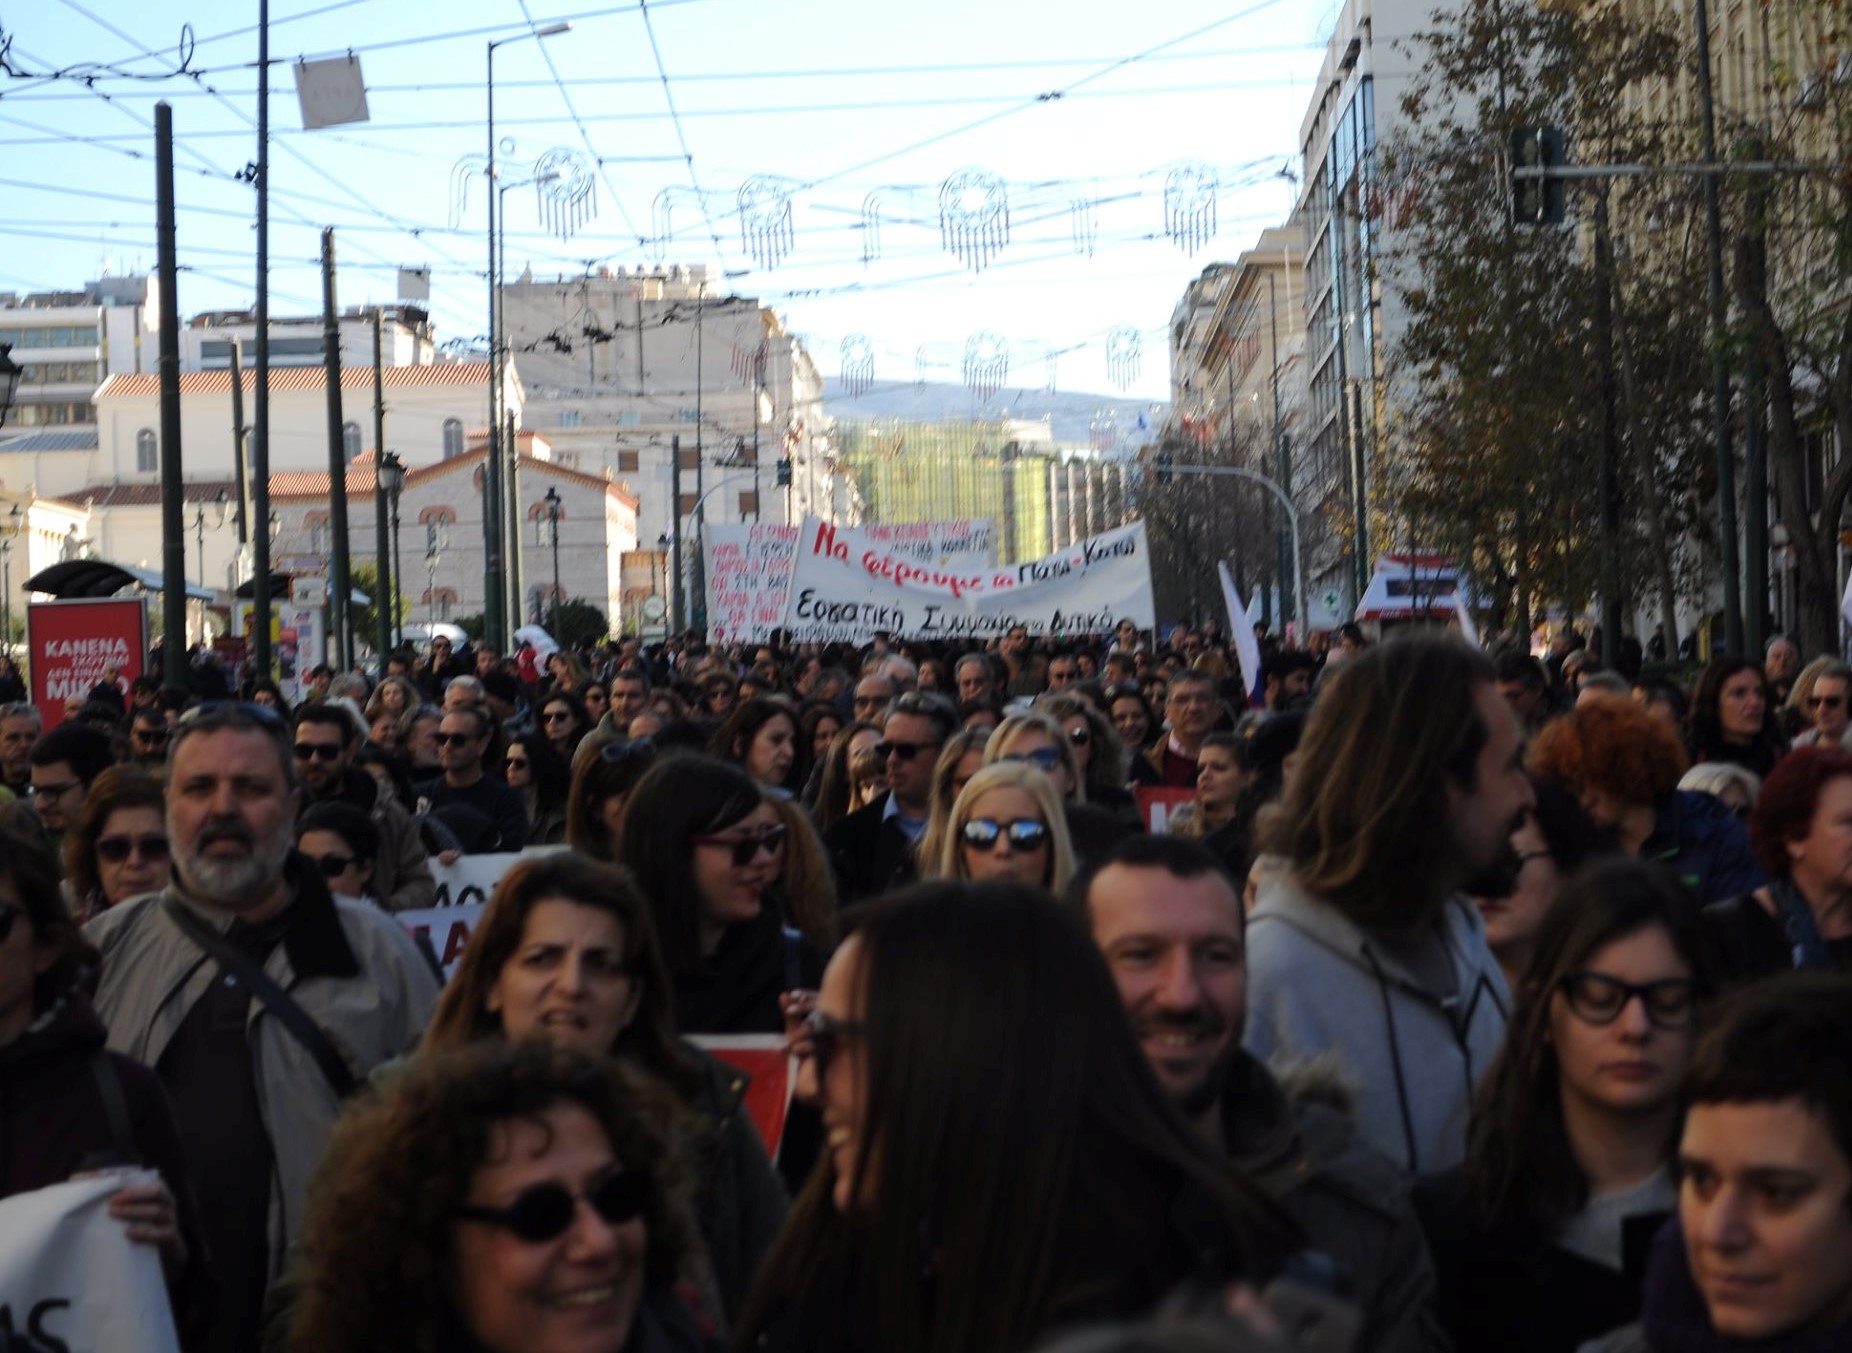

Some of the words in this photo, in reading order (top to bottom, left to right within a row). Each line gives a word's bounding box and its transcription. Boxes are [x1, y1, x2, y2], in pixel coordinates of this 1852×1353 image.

[813, 521, 850, 565] Να
[861, 549, 985, 600] φέρουμε
[45, 638, 128, 657] ΚΑΝΕΝΑ
